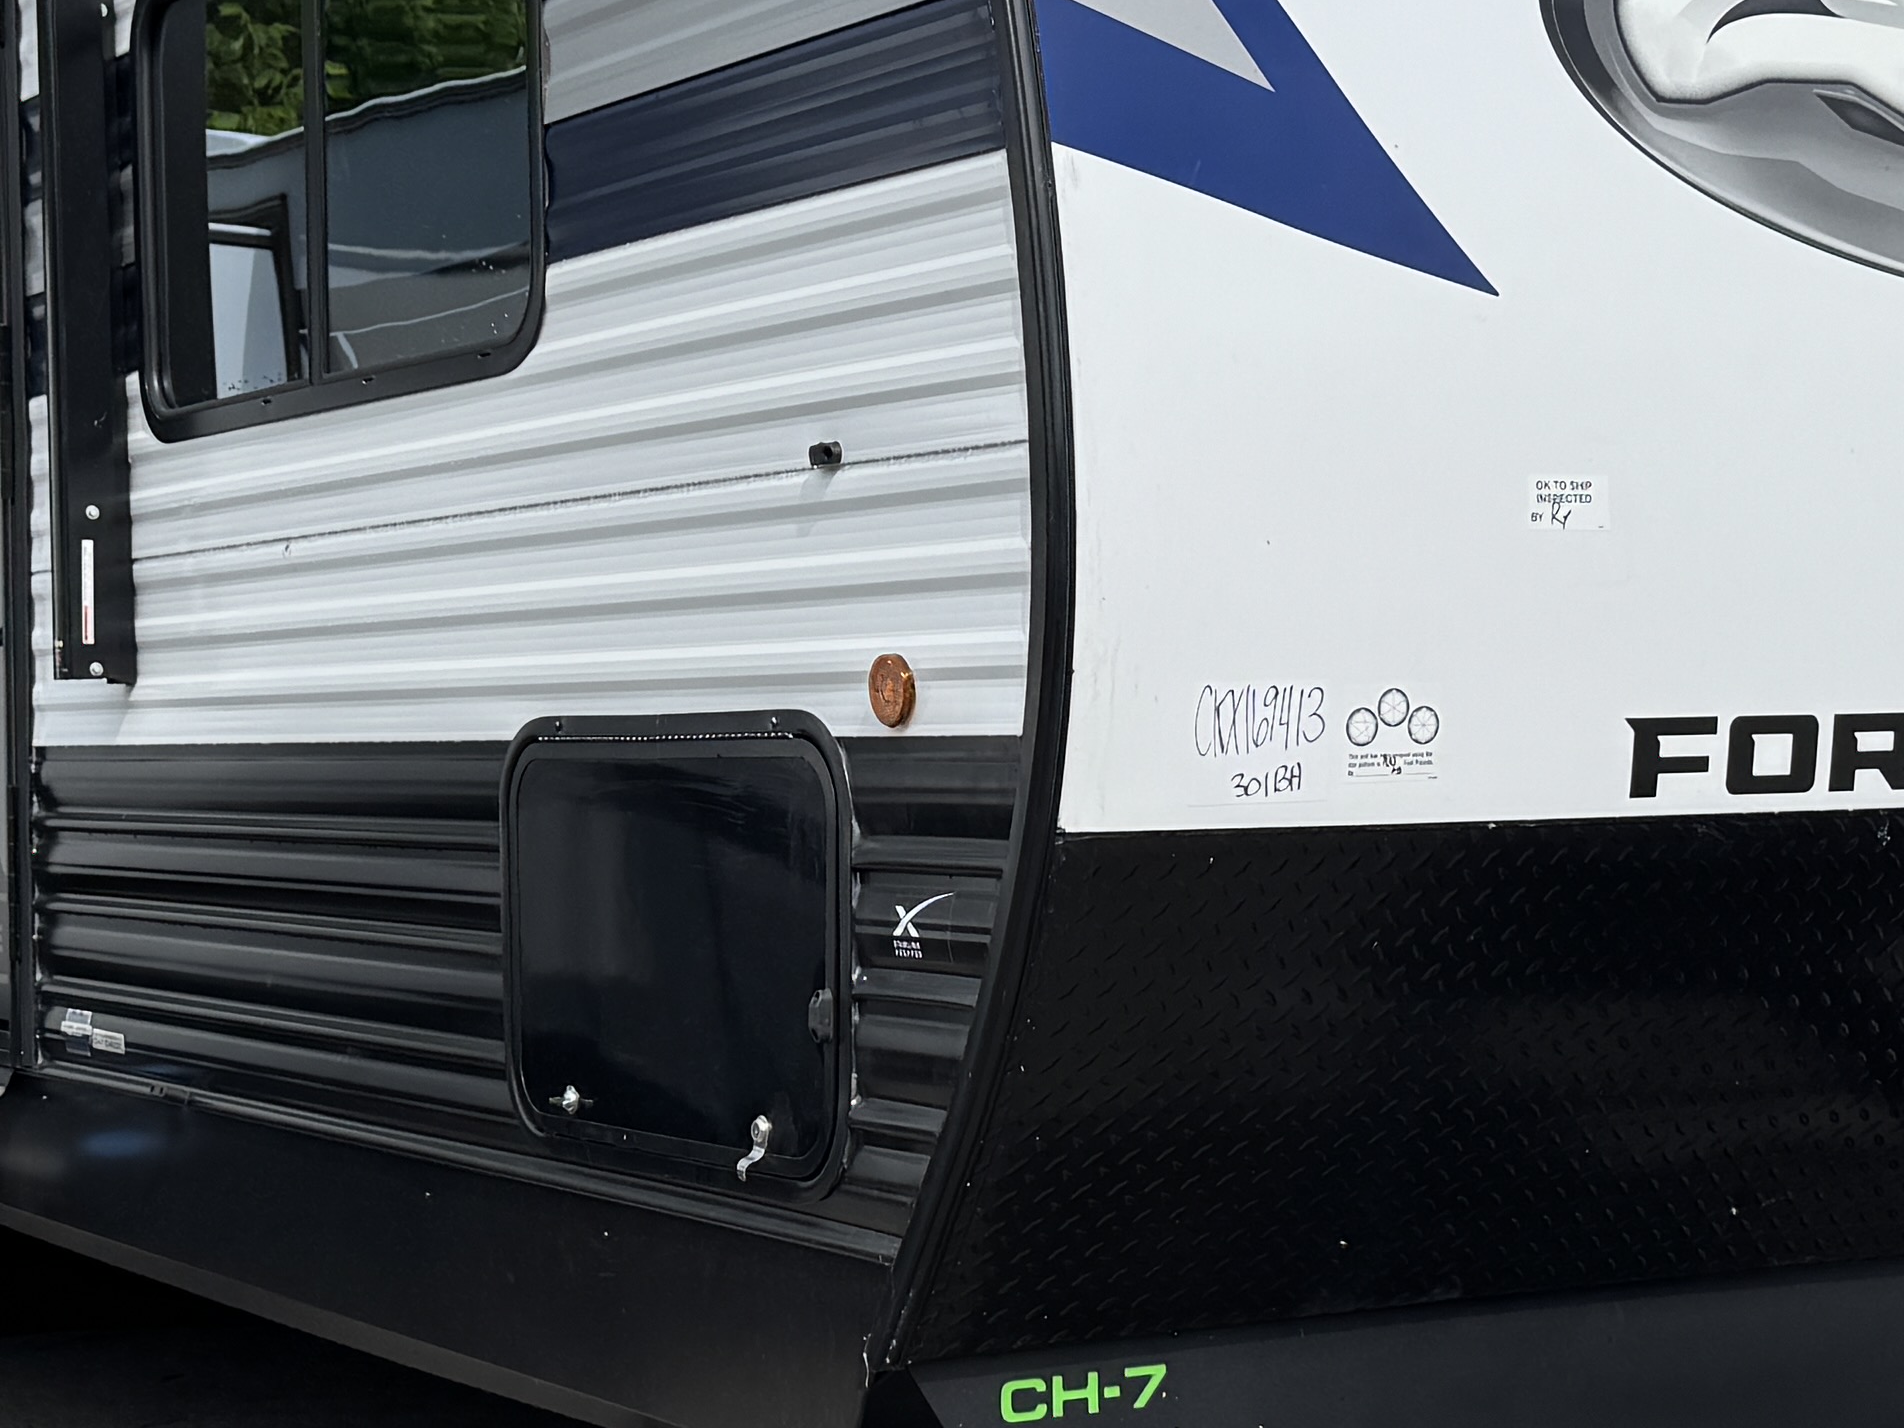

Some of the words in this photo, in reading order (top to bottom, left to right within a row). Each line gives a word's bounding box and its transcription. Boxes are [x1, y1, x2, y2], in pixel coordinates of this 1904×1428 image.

[1536, 480, 1551, 491] OK
[1553, 480, 1567, 491] TO
[1531, 512, 1543, 522] BY
[1000, 1363, 1167, 1423] CH-7
